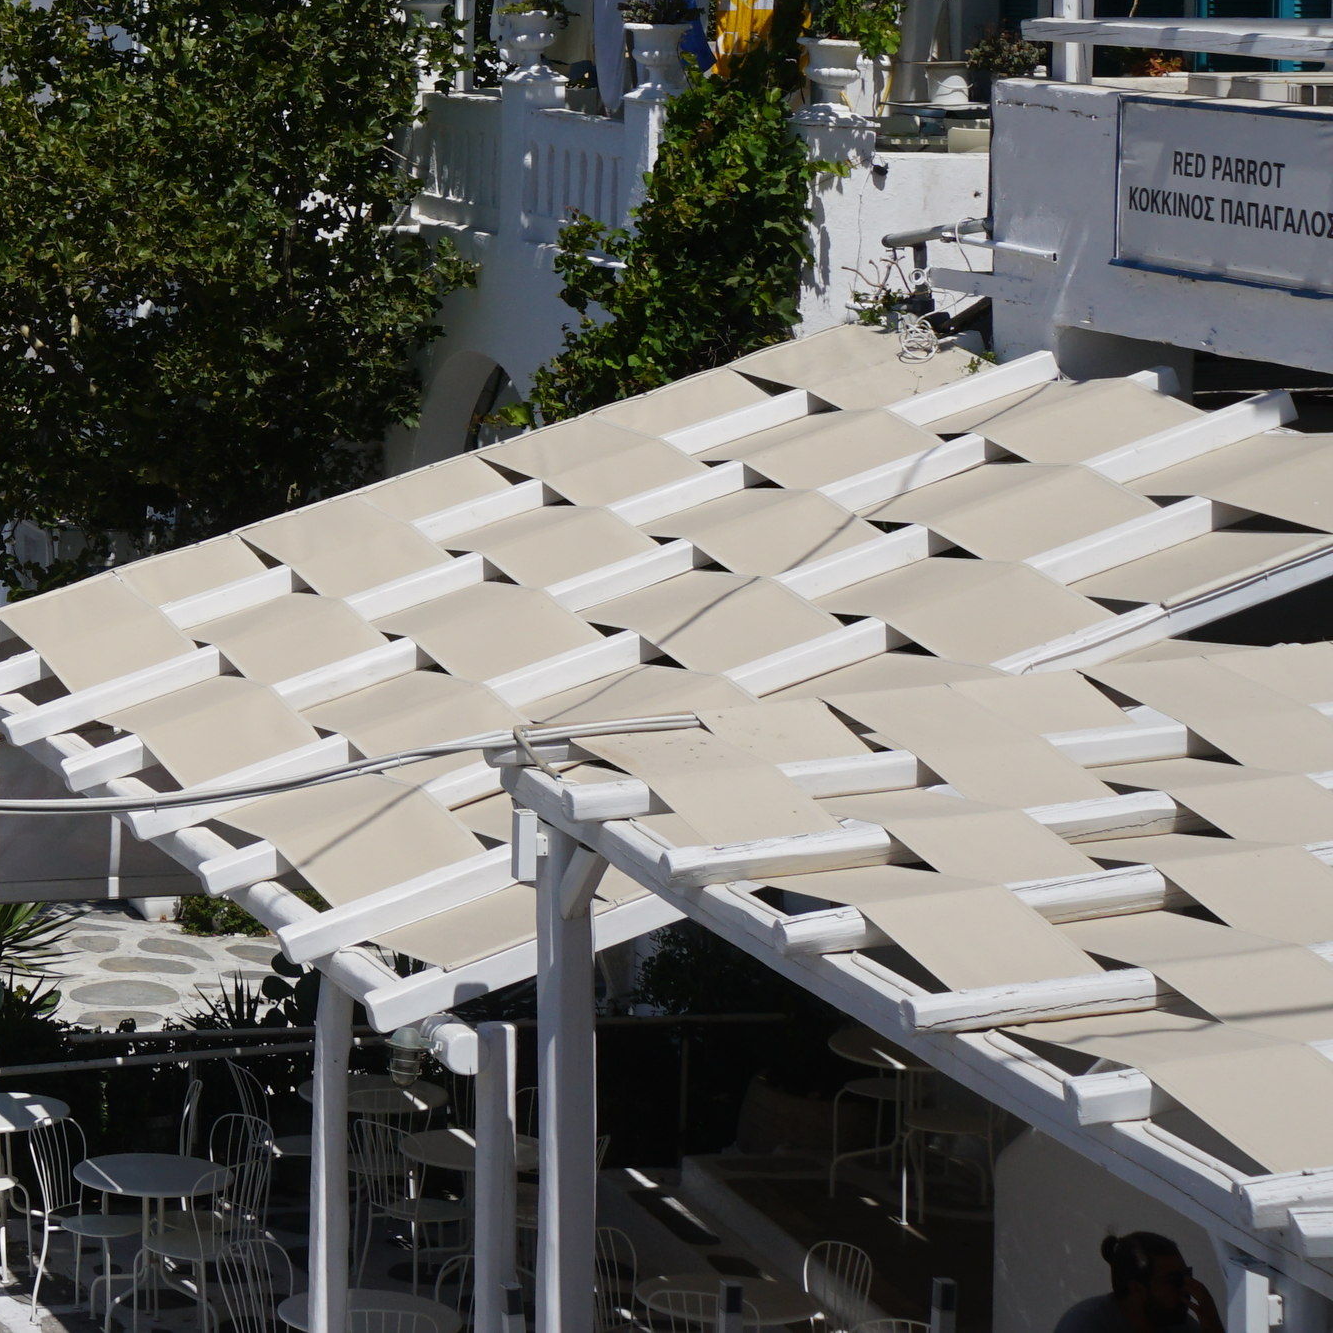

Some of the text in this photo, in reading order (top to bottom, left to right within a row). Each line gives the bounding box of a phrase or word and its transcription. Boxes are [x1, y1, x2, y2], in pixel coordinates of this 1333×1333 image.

[1172, 150, 1286, 189] RED PARROT
[1128, 185, 1333, 240] ΚΟΚΚΙΝΟΣ ΠΑΠΑΓΑΛΟΣ
